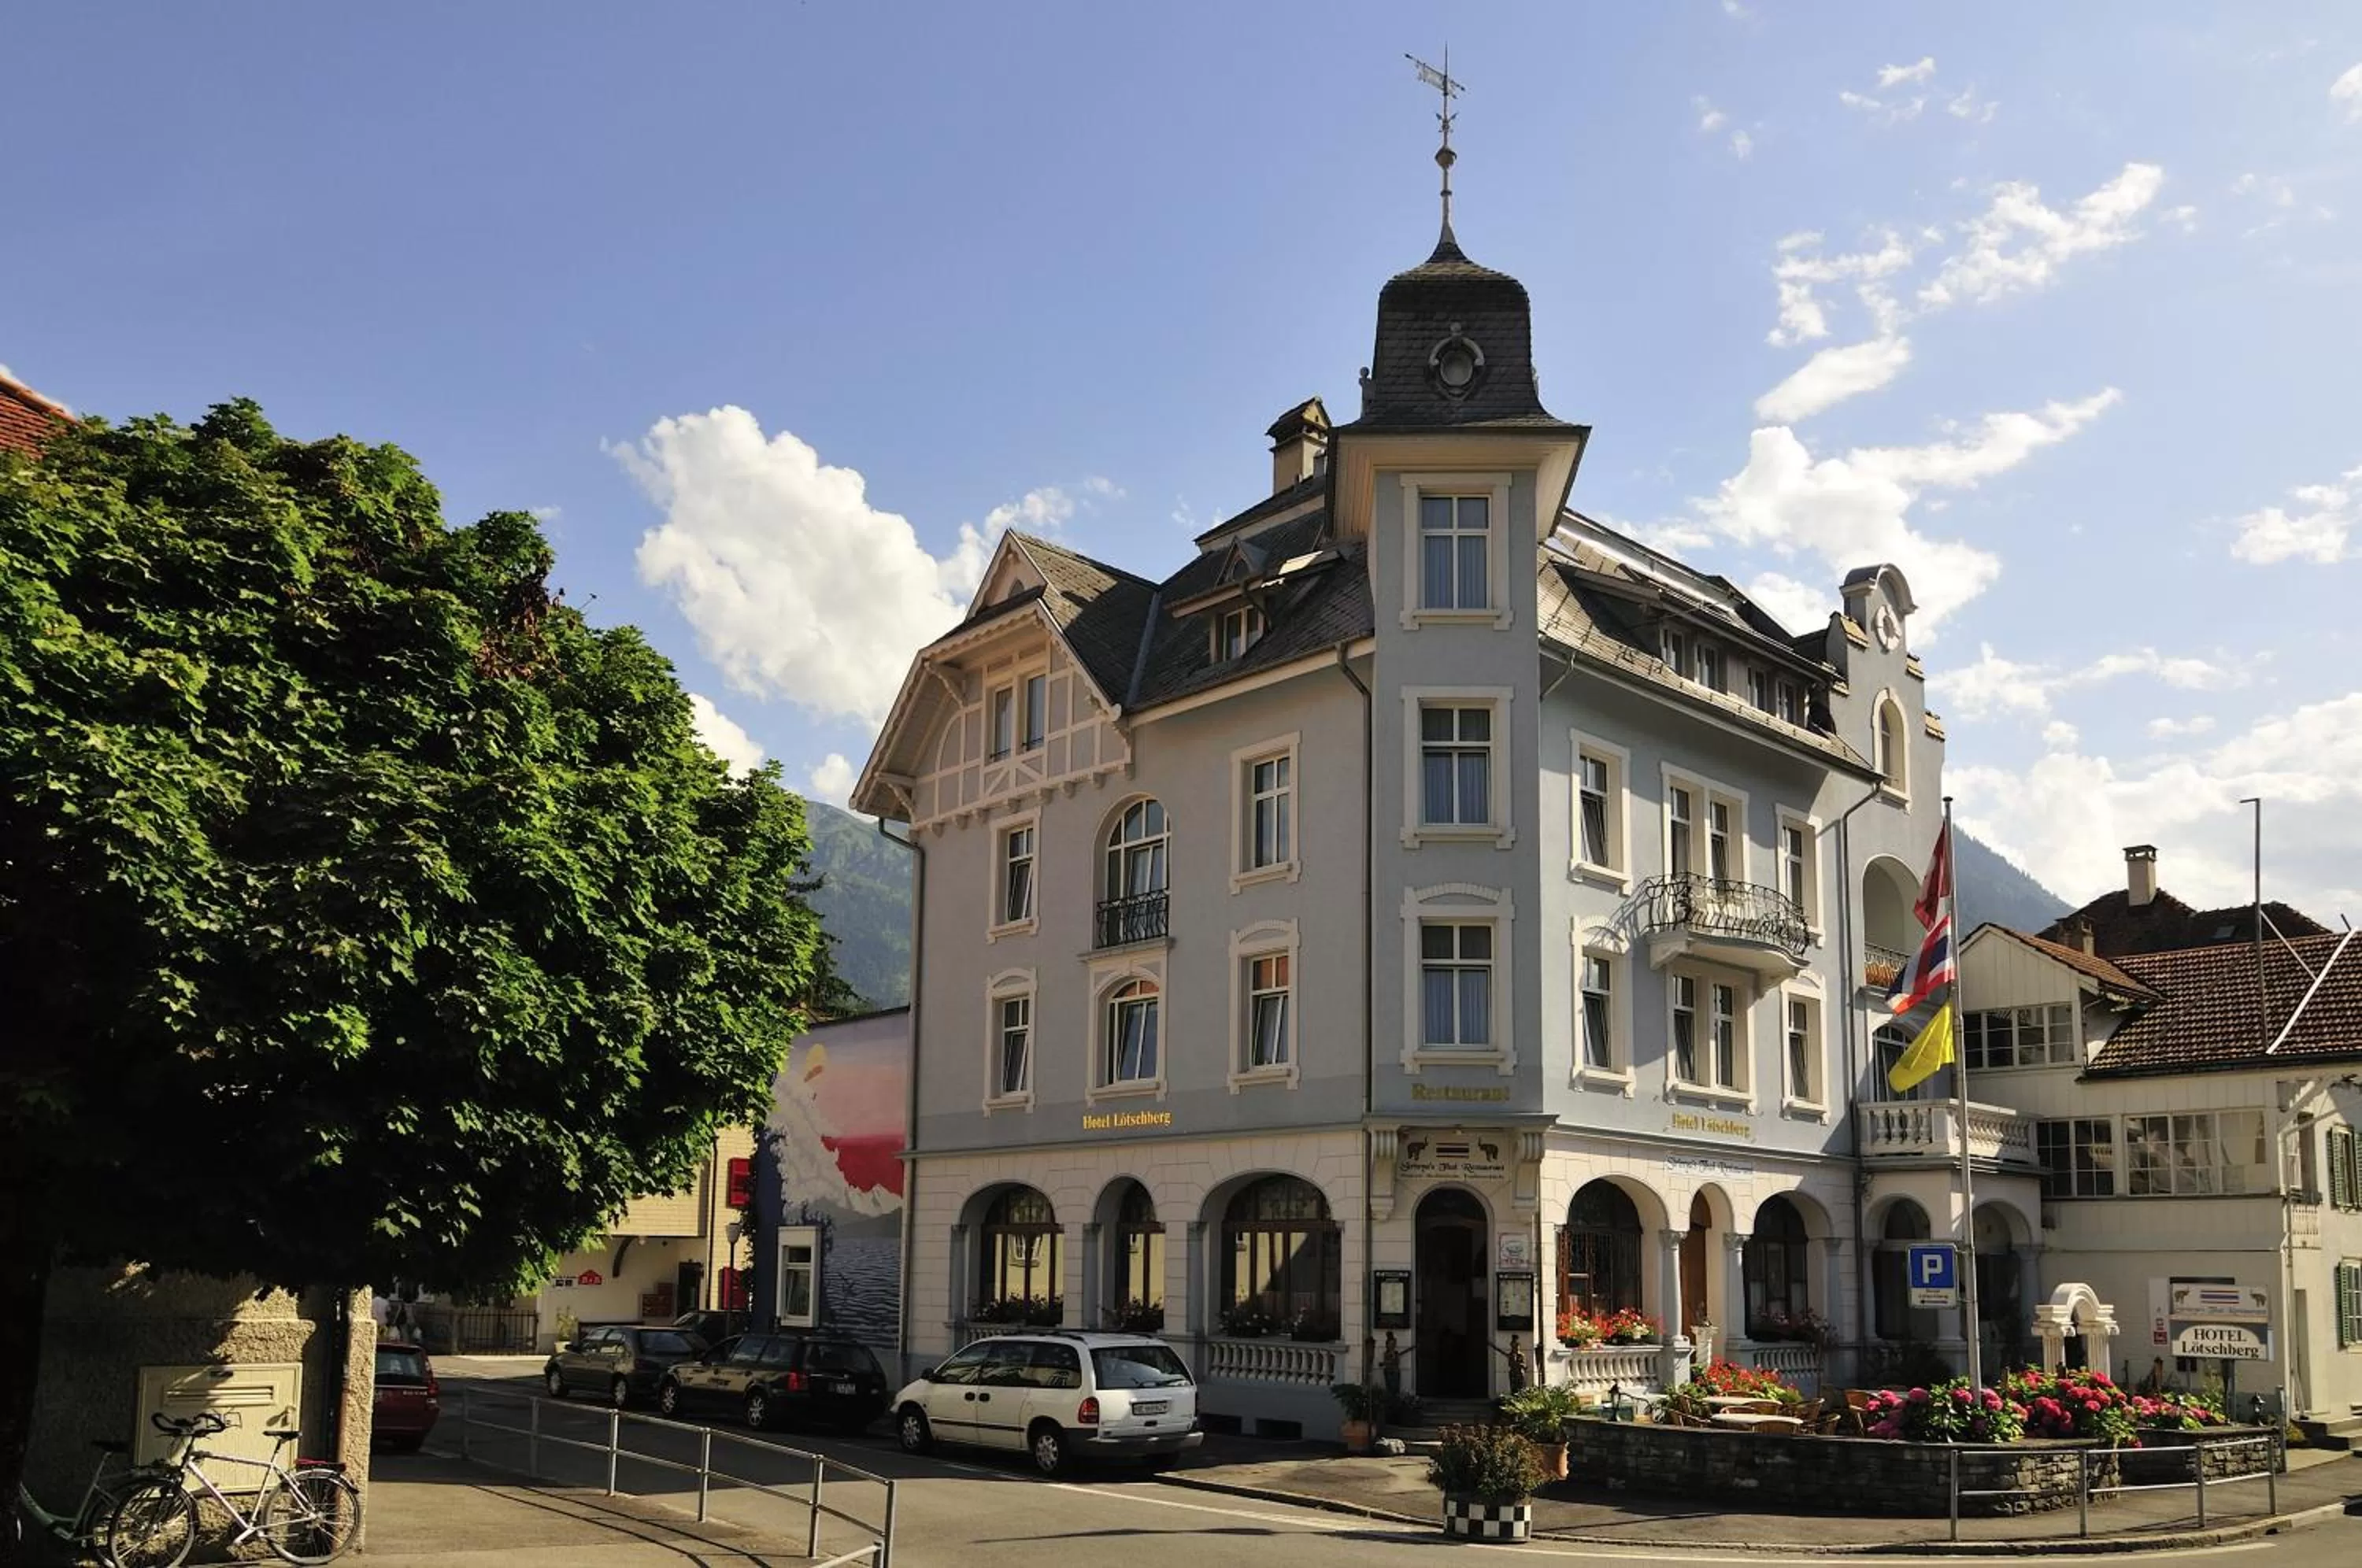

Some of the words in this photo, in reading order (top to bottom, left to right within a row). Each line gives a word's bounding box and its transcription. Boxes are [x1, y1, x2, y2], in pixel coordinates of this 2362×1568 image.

[1411, 1083, 1512, 1102] Restaurant
[1083, 1114, 1109, 1130] Hotel
[1113, 1111, 1172, 1128] Lötschberg
[1672, 1112, 1698, 1130] Hotel
[1922, 1254, 1943, 1284] P
[2194, 1328, 2247, 1342] HOTEL
[2181, 1341, 2260, 1359] Lötschberg
